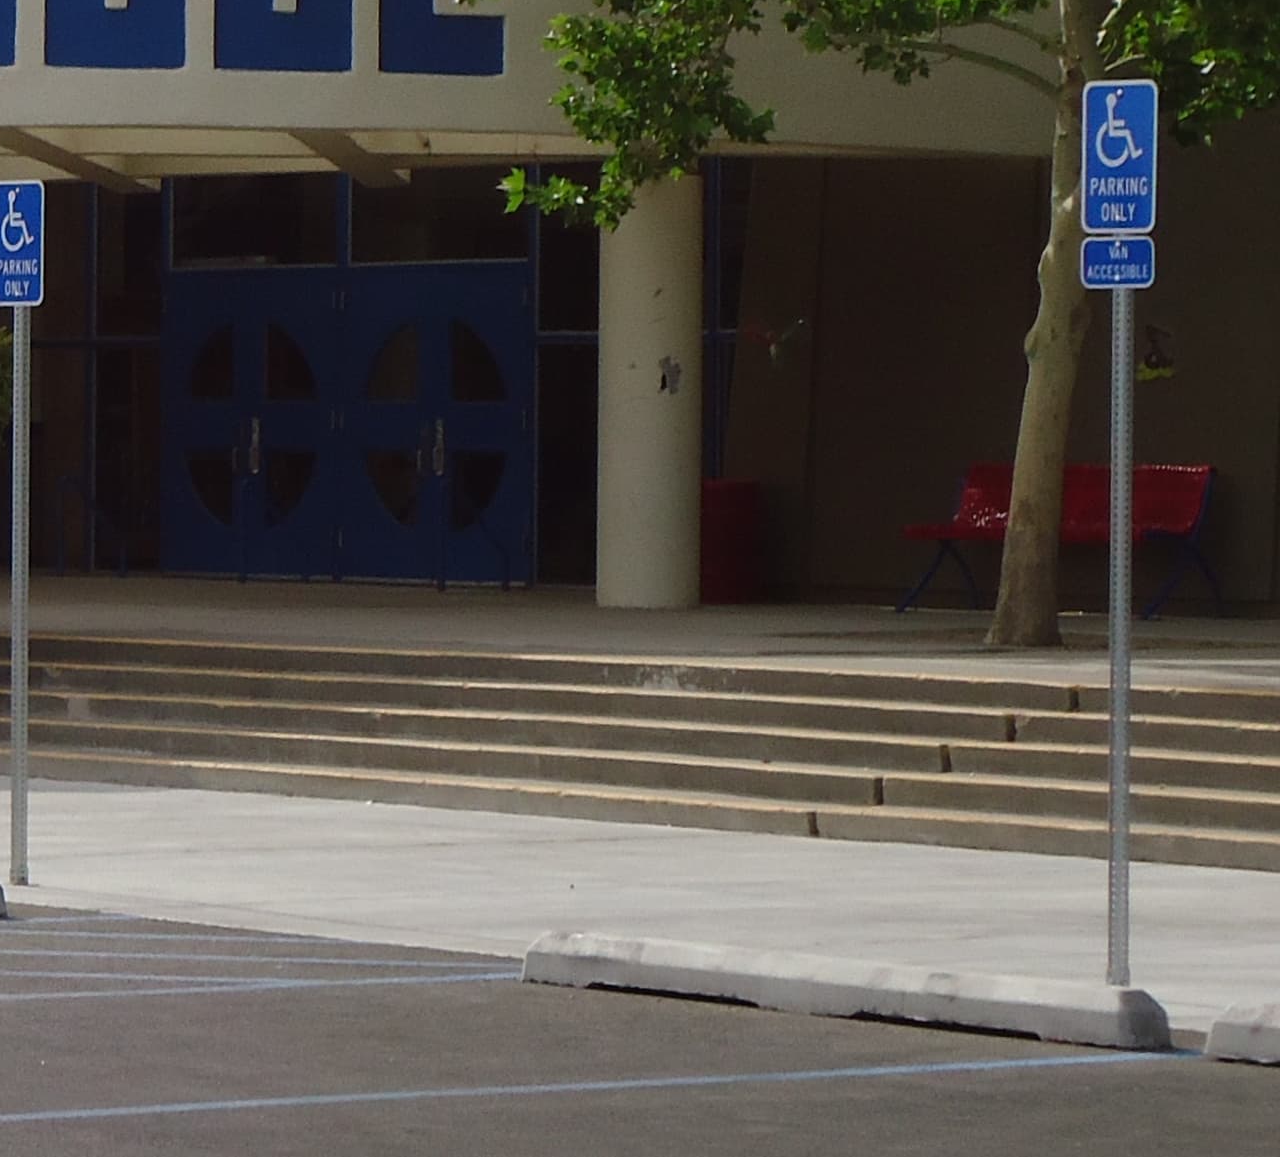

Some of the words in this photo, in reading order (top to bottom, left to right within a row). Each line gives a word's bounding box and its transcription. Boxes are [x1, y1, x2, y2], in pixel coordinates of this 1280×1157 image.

[1089, 177, 1149, 197] PARKING
[1100, 202, 1136, 222] ONLY
[1108, 244, 1129, 260] VAN
[1087, 264, 1149, 280] ACCESSIBLE
[3, 279, 31, 297] ONLY
